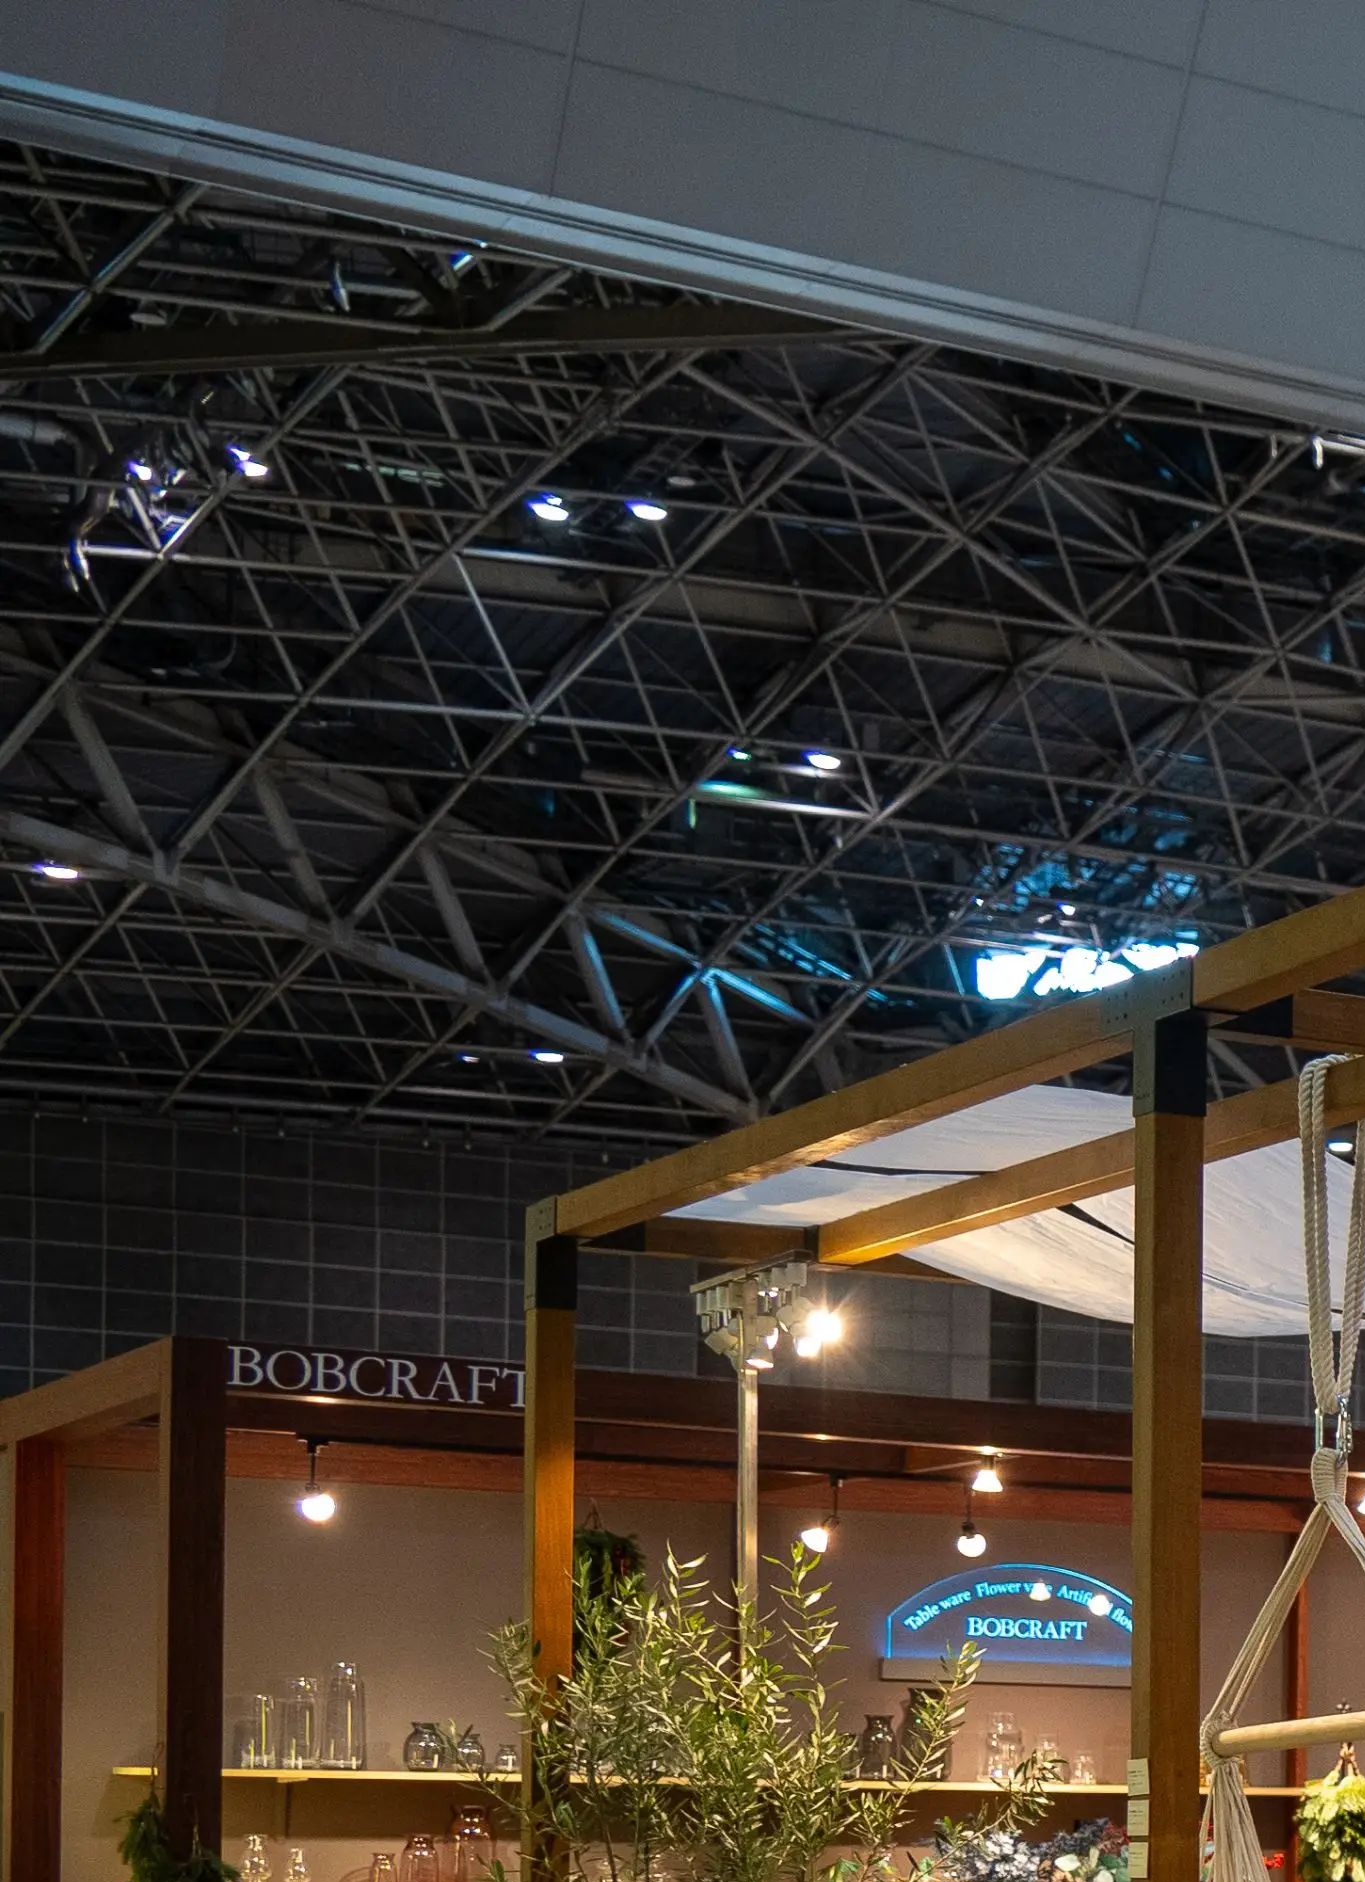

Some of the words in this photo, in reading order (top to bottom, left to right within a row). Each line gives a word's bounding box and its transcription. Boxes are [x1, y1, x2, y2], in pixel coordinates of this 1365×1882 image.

[227, 1345, 526, 1408] BOBCRAFT
[903, 1604, 941, 1631] Table
[938, 1590, 972, 1610] ware
[975, 1581, 1021, 1598] Flower
[966, 1616, 1088, 1641] BOBCRAFT
